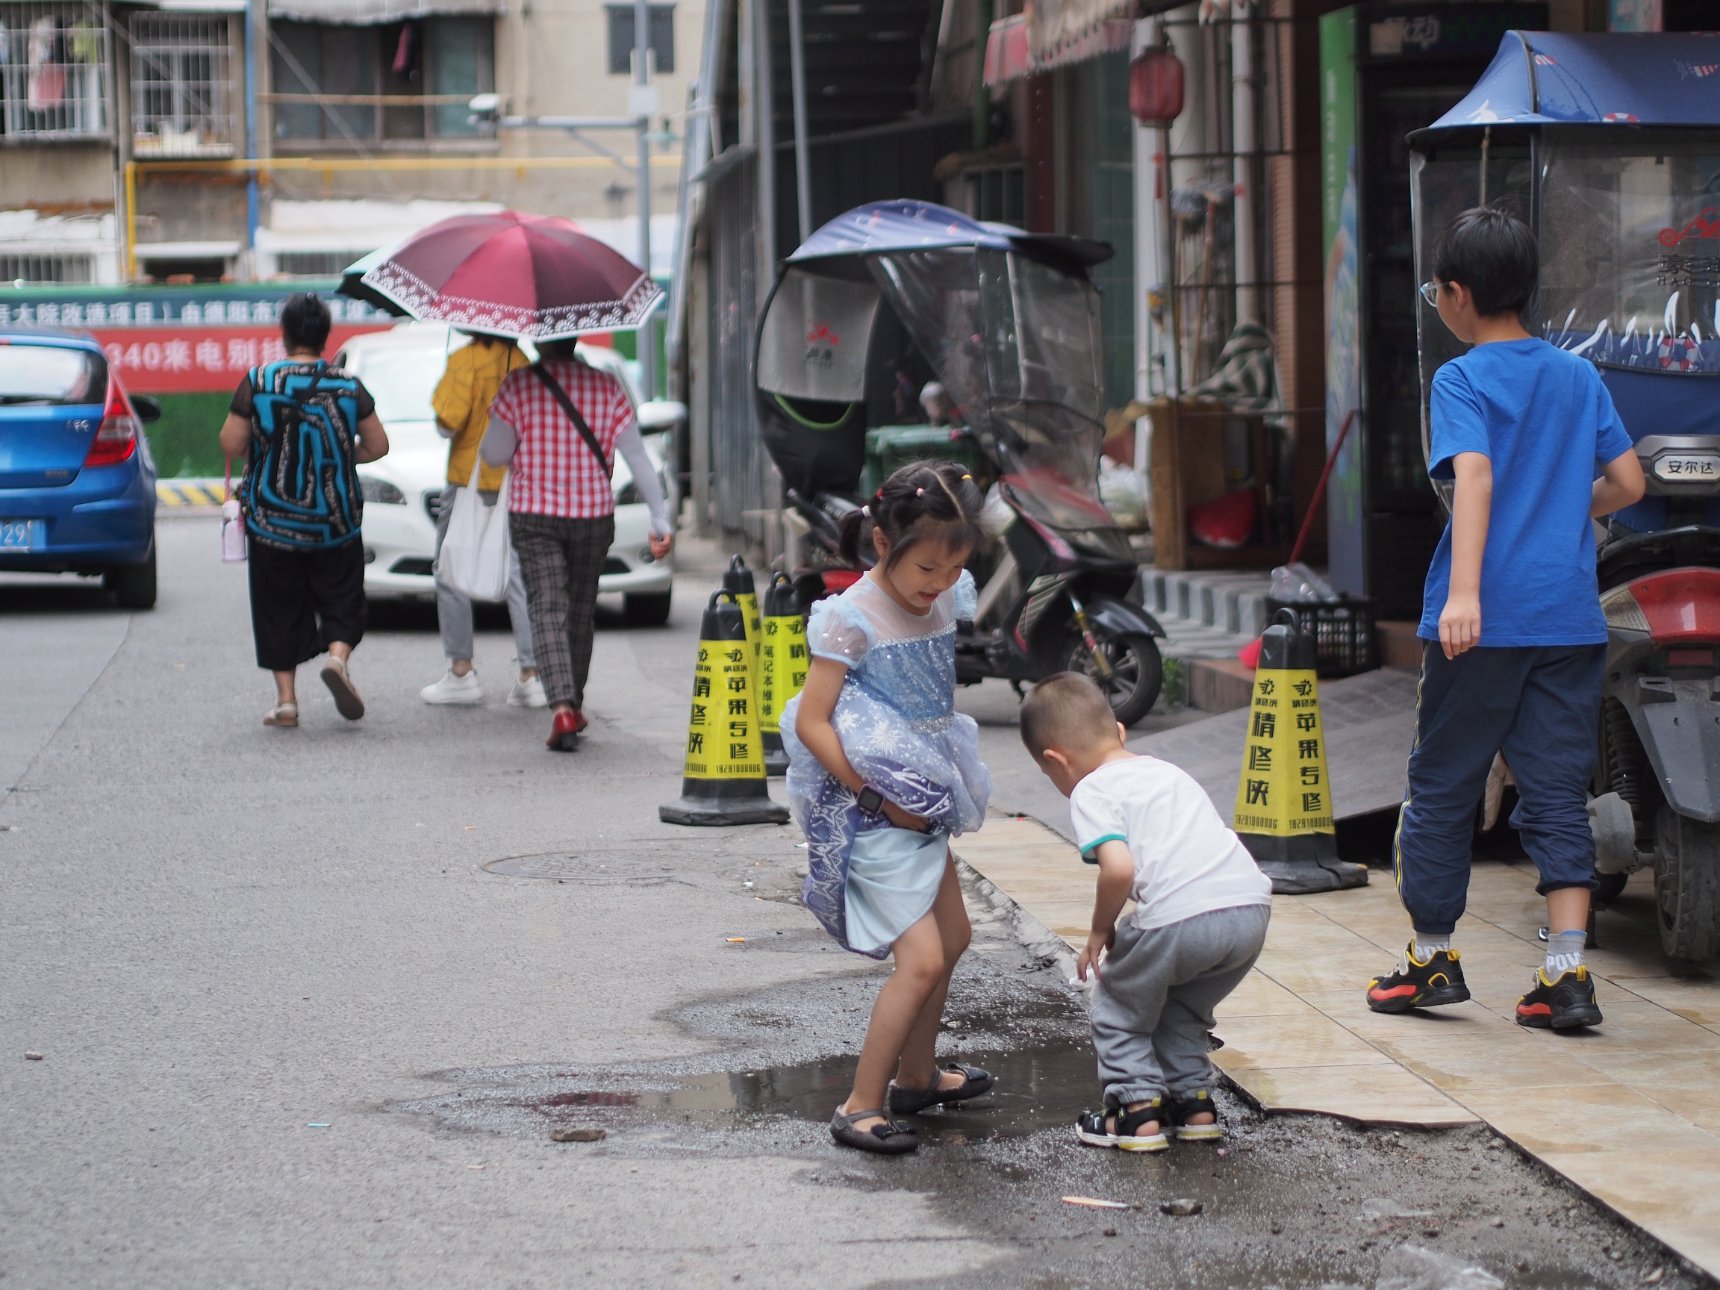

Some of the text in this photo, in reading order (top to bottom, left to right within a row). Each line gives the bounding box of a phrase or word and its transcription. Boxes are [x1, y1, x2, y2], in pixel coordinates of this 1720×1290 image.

[1667, 460, 1714, 474] 安尔达
[727, 676, 749, 760] 苹果专修
[1245, 710, 1277, 807] 精修侠
[1296, 713, 1322, 812] 苹果专修
